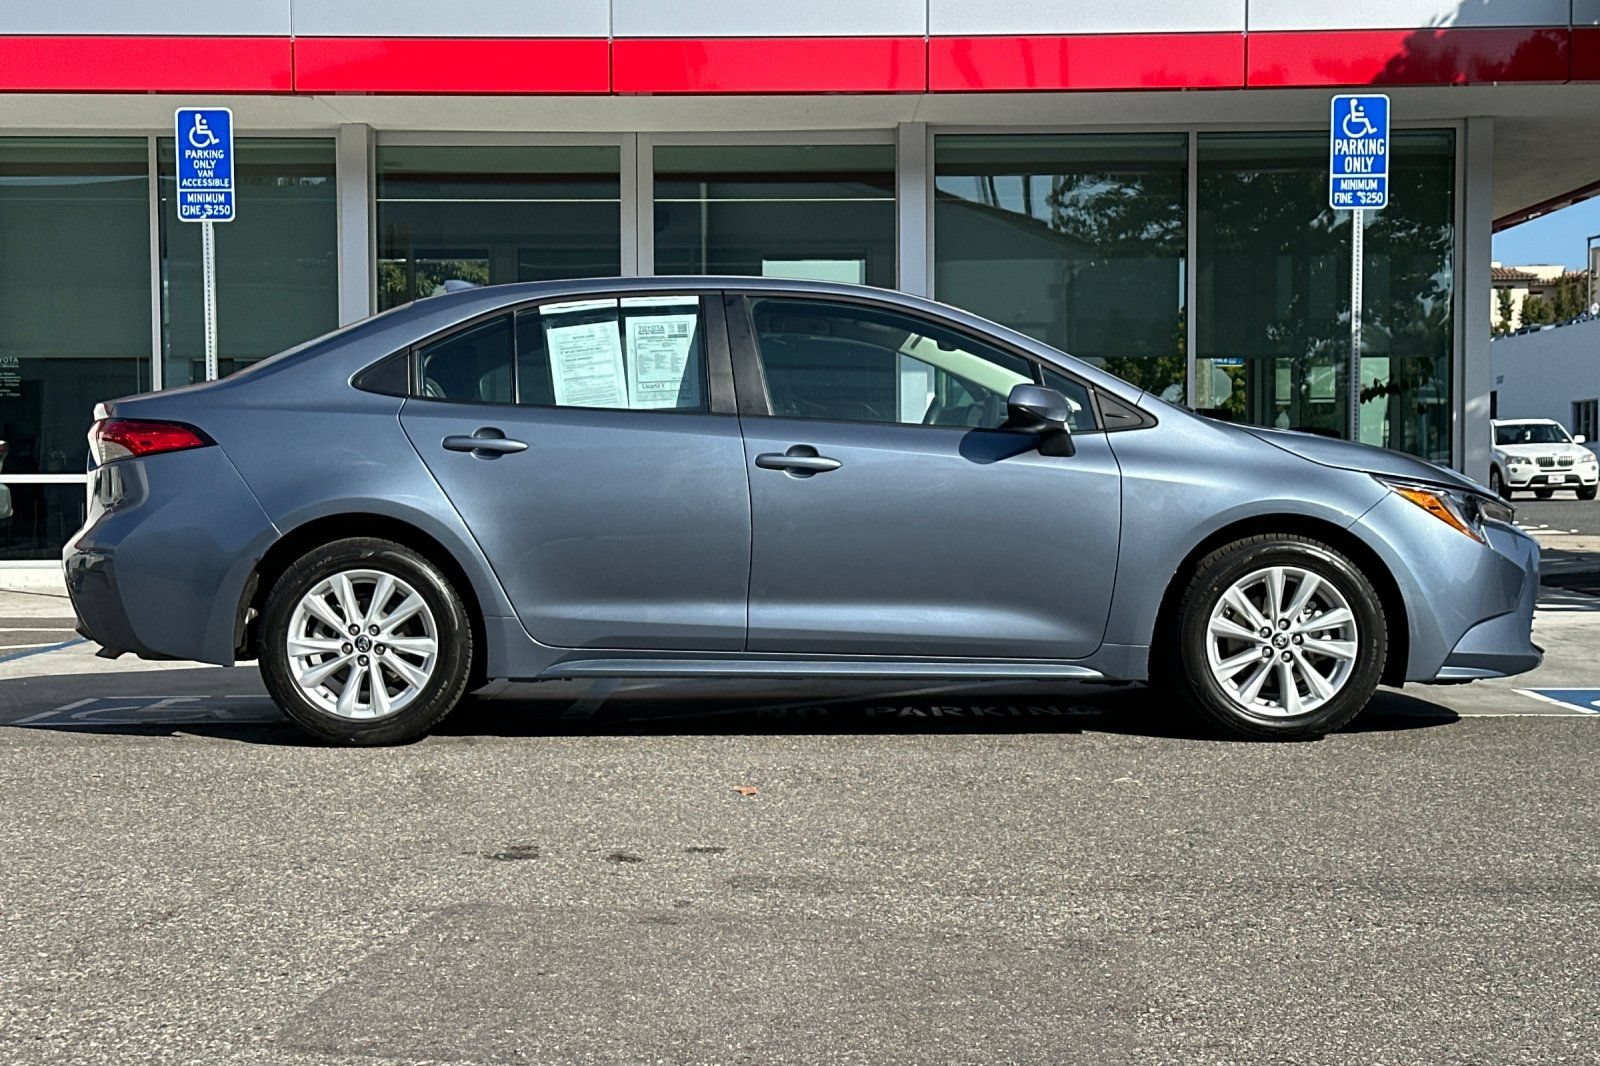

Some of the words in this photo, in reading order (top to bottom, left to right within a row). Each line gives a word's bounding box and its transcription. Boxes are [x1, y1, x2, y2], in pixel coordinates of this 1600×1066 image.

[1335, 139, 1385, 156] PARKING
[185, 149, 225, 159] PARKING
[193, 160, 217, 169] ONLY
[1344, 156, 1374, 173] ONLY
[197, 169, 214, 178] VAN
[181, 178, 230, 188] ACCESSIBLE
[1340, 179, 1378, 191] MINIMUM
[187, 193, 225, 203] MINIMUM
[1334, 192, 1354, 204] FINE
[1359, 192, 1384, 204] $250
[182, 205, 202, 216] FINE
[865, 706, 1104, 718] PARKING
